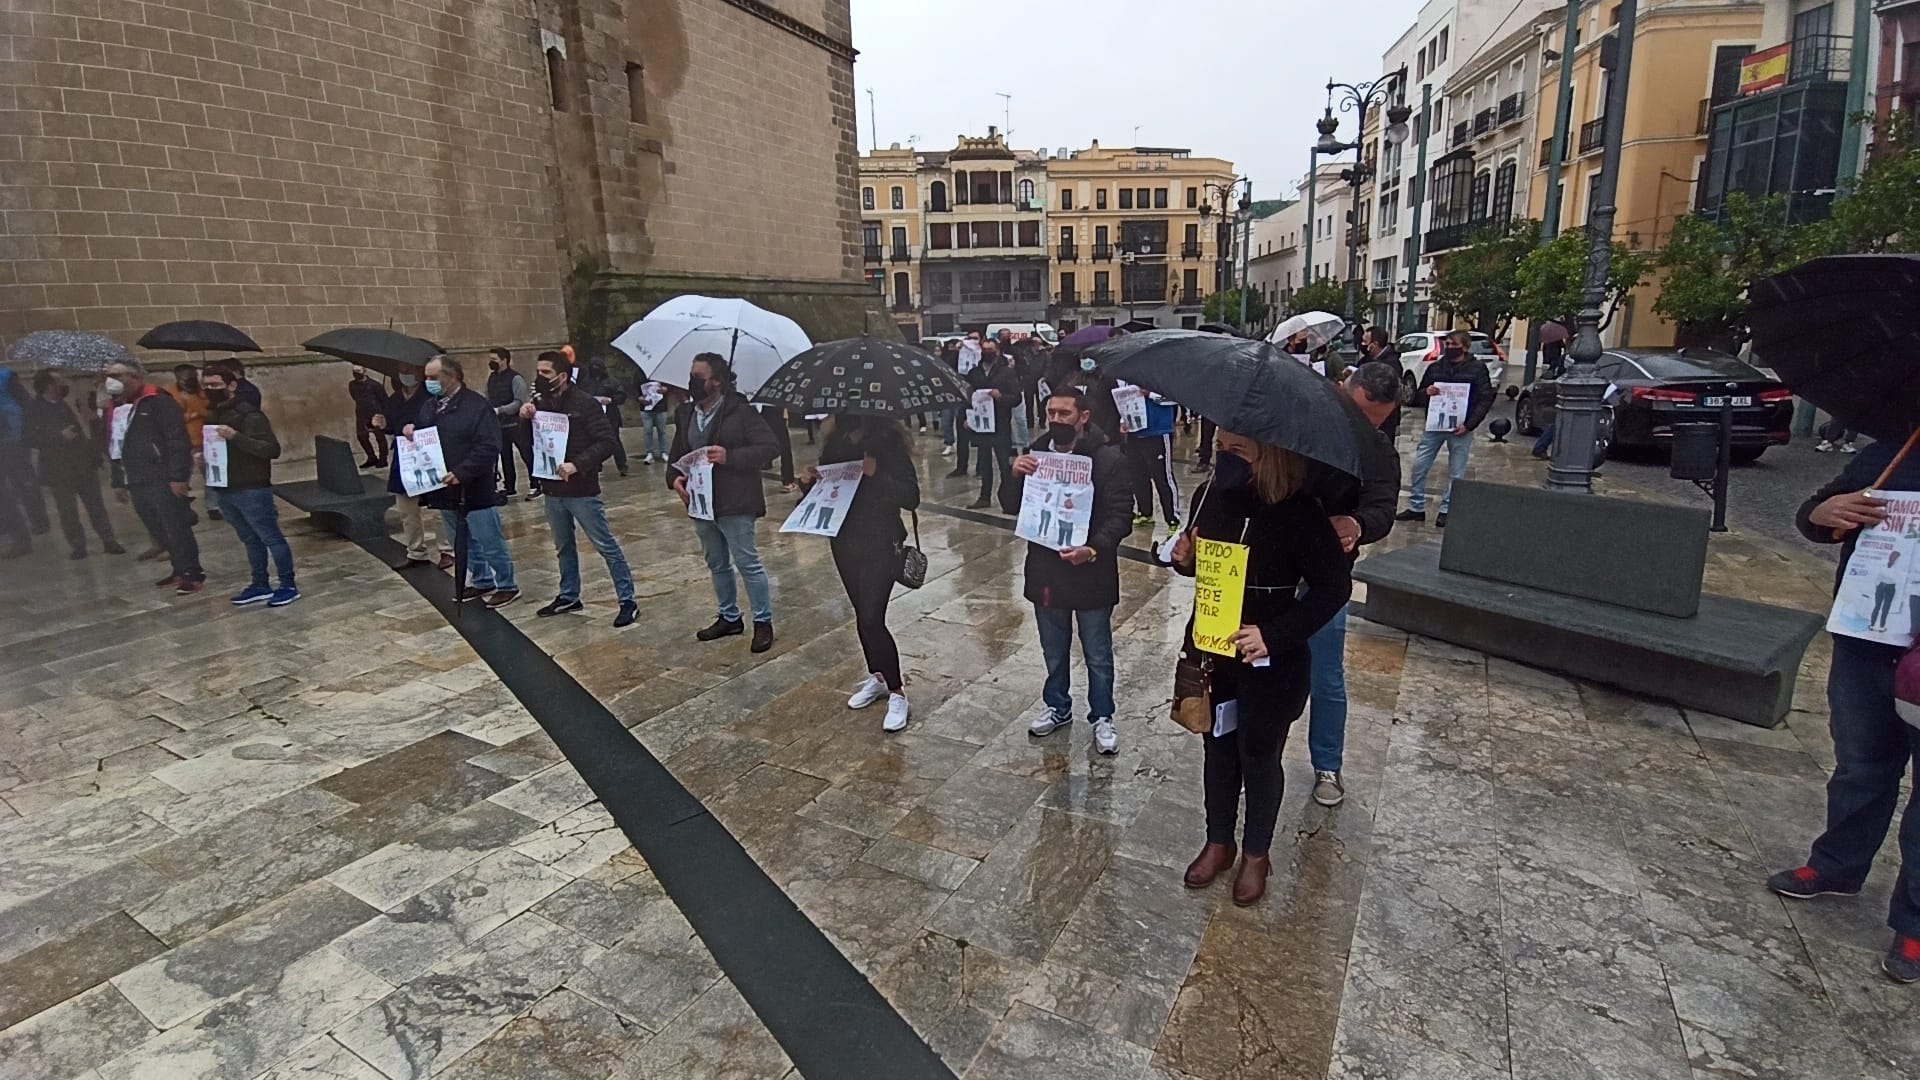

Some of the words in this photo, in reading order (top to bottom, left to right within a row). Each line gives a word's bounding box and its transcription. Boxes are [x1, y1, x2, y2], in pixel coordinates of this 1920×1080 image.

[1881, 515, 1906, 533] SIN
[1204, 541, 1233, 559] PUDO
[1228, 564, 1239, 577] A
